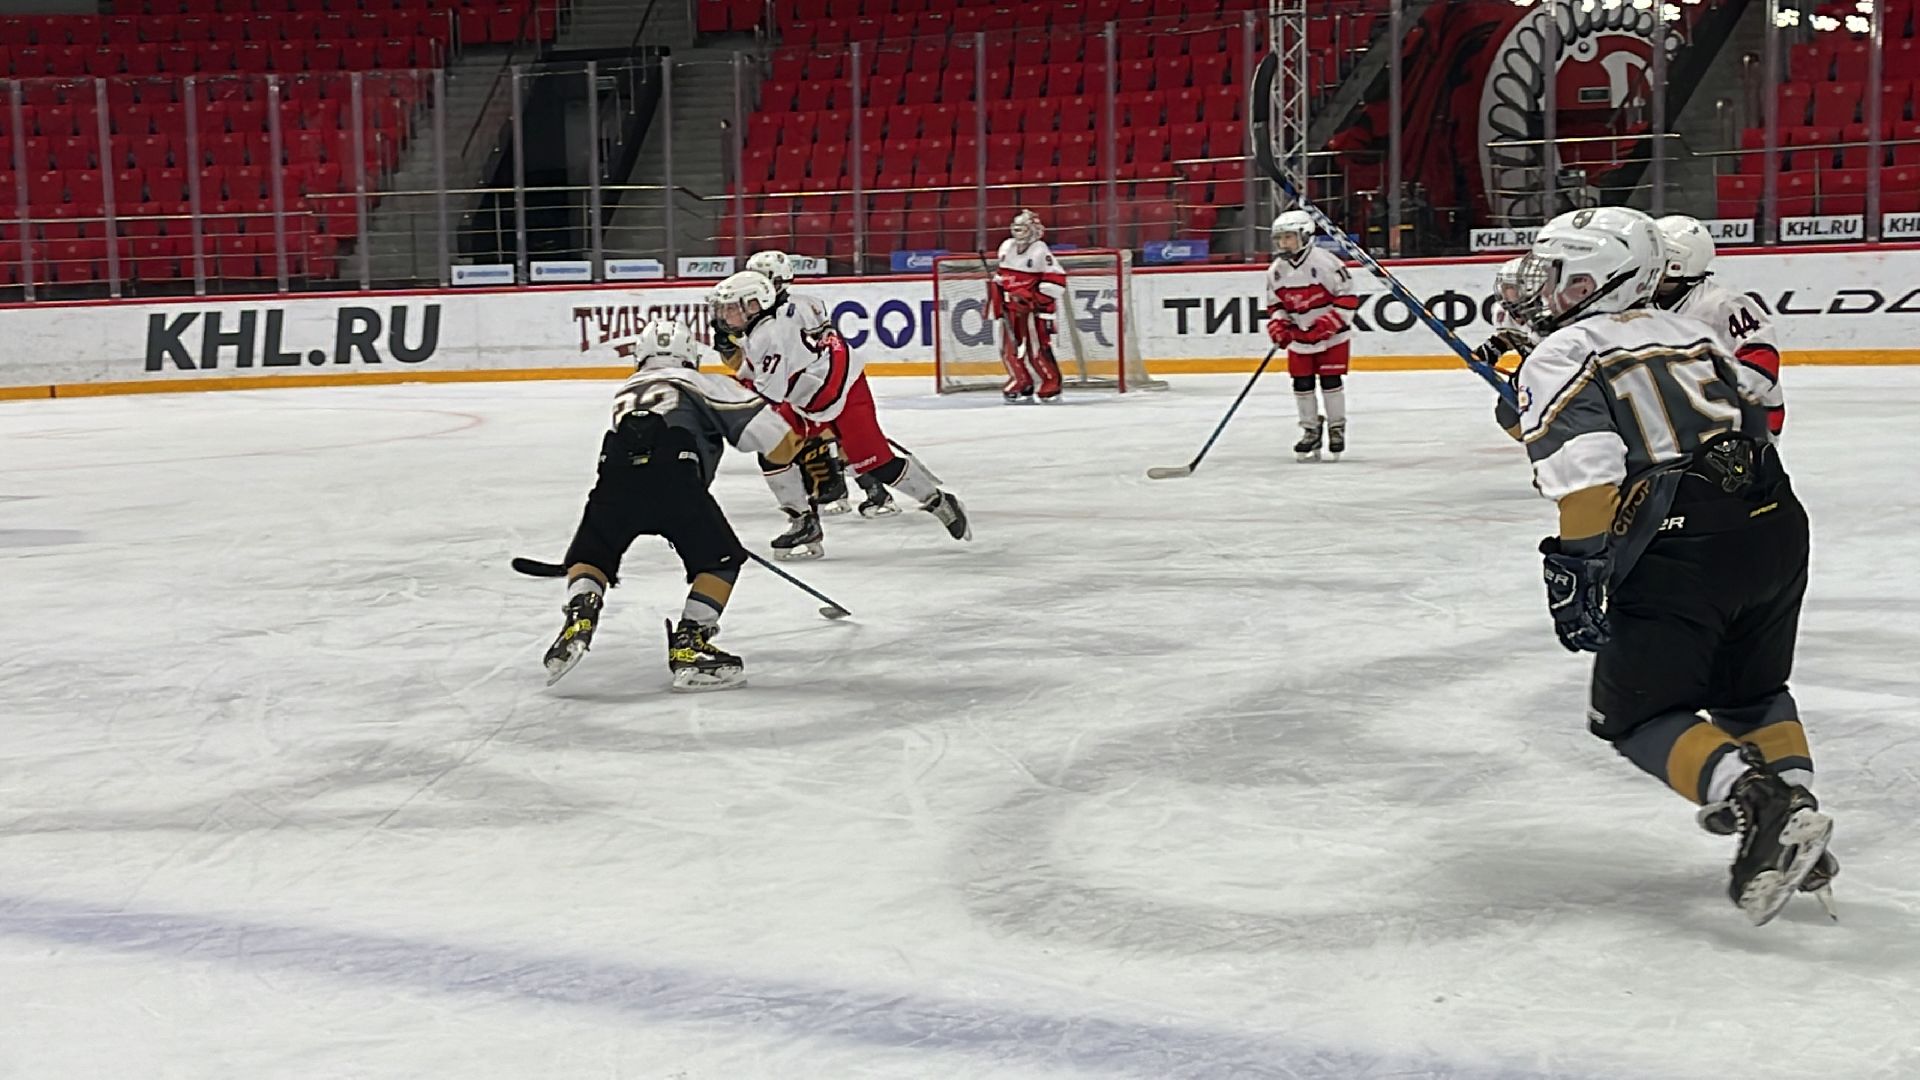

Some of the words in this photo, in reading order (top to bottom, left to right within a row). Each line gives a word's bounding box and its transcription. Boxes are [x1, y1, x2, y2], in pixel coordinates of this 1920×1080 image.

[1786, 219, 1857, 236] KHL.RU
[687, 261, 726, 273] PARI
[792, 259, 818, 270] ARI
[573, 303, 711, 352] ТУЛЬСКИ
[1163, 289, 1495, 335] ТИНКОФ
[1728, 307, 1760, 340] 44
[145, 303, 441, 372] KHL.RU
[1608, 359, 1743, 464] 15
